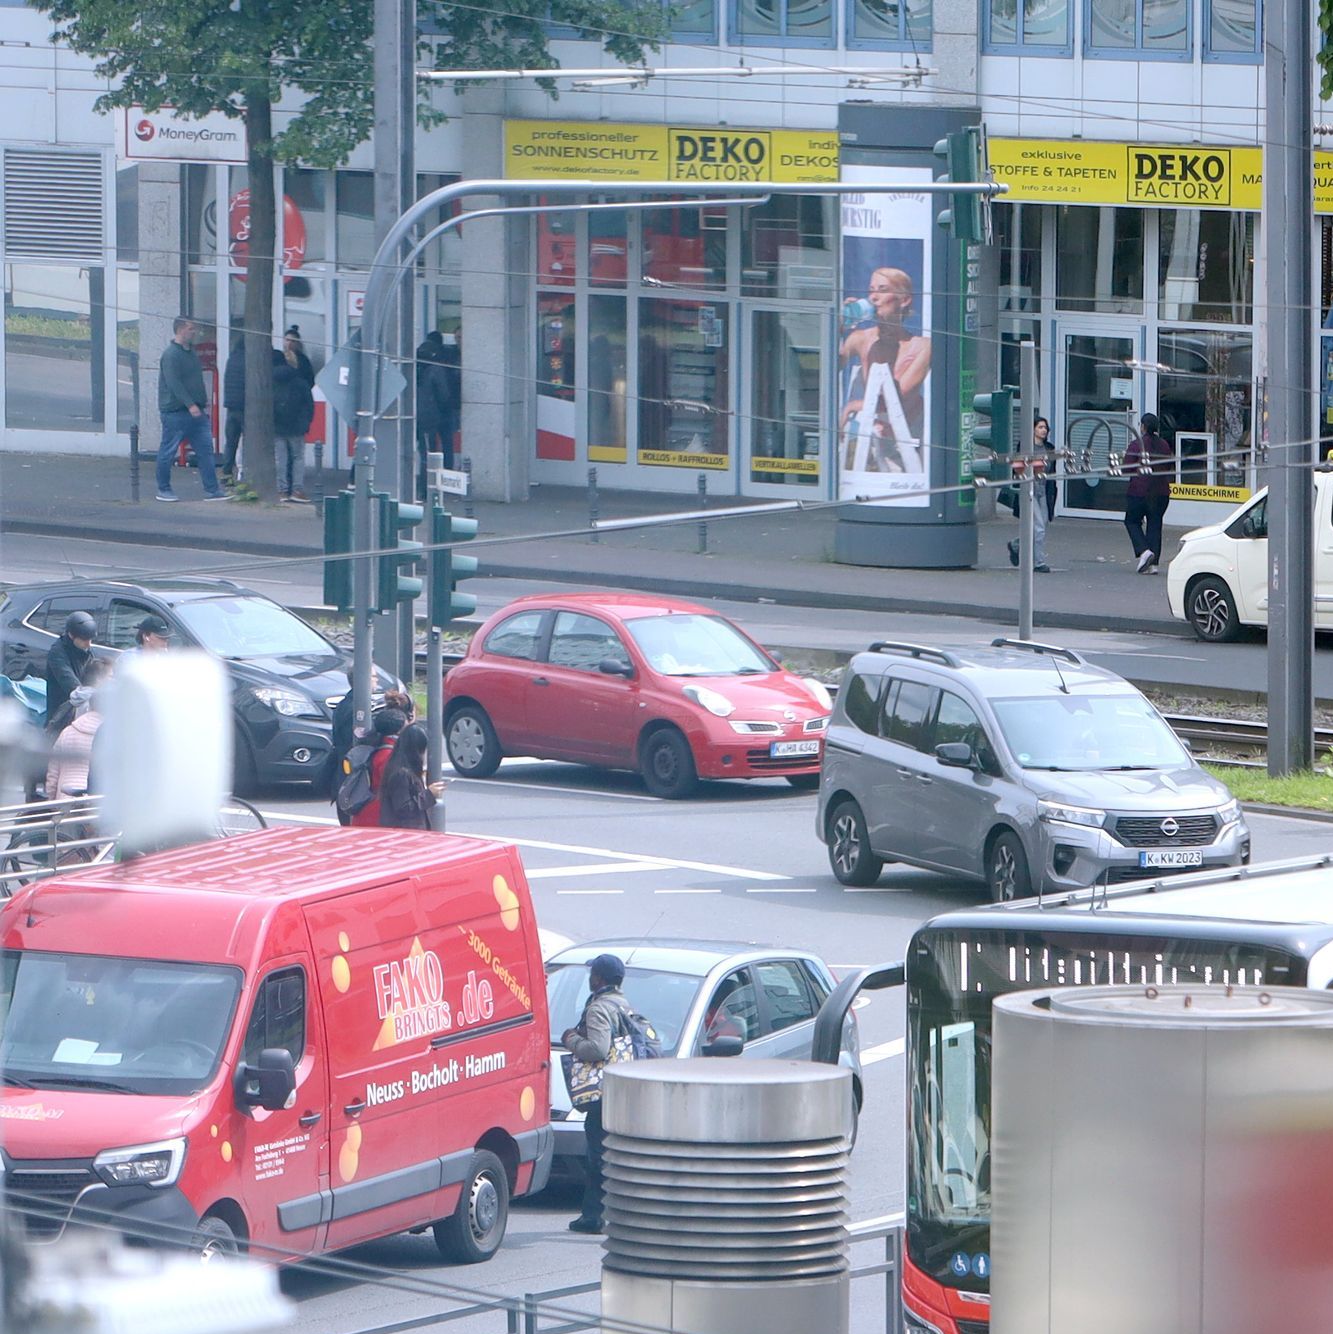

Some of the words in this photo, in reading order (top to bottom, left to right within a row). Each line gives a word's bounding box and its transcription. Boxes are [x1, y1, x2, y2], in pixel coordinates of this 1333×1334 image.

[158, 127, 237, 142] MoneyGram
[531, 130, 640, 143] professioneller
[511, 144, 659, 161] SONNENSCHUTZ
[675, 135, 765, 164] DEKO
[1021, 150, 1082, 161] exklusive
[675, 163, 764, 182] FACTORY
[989, 164, 1039, 177] STOFFE
[1042, 166, 1053, 177] &
[1057, 167, 1117, 180] TAPETEN
[1134, 153, 1224, 182] DEKO
[1021, 184, 1039, 193] Info
[1041, 185, 1054, 193] 24
[1056, 185, 1069, 193] 24
[1134, 180, 1224, 200] FACTORY
[642, 453, 671, 463] ROLLOS
[677, 455, 724, 466] RAFFROLLOS
[1169, 485, 1240, 499] SONNENSCHIRME
[1147, 853, 1155, 864] K
[1161, 853, 1175, 864] KW
[1176, 852, 1201, 864] 2023
[466, 929, 492, 965] 3000
[492, 957, 531, 1011] Getränke
[373, 950, 444, 1020] FAKO
[394, 1001, 452, 1042] BRINGTS
[366, 1078, 405, 1107] Neuss
[411, 1058, 459, 1095] Bocholt
[465, 1051, 506, 1079] Hamm
